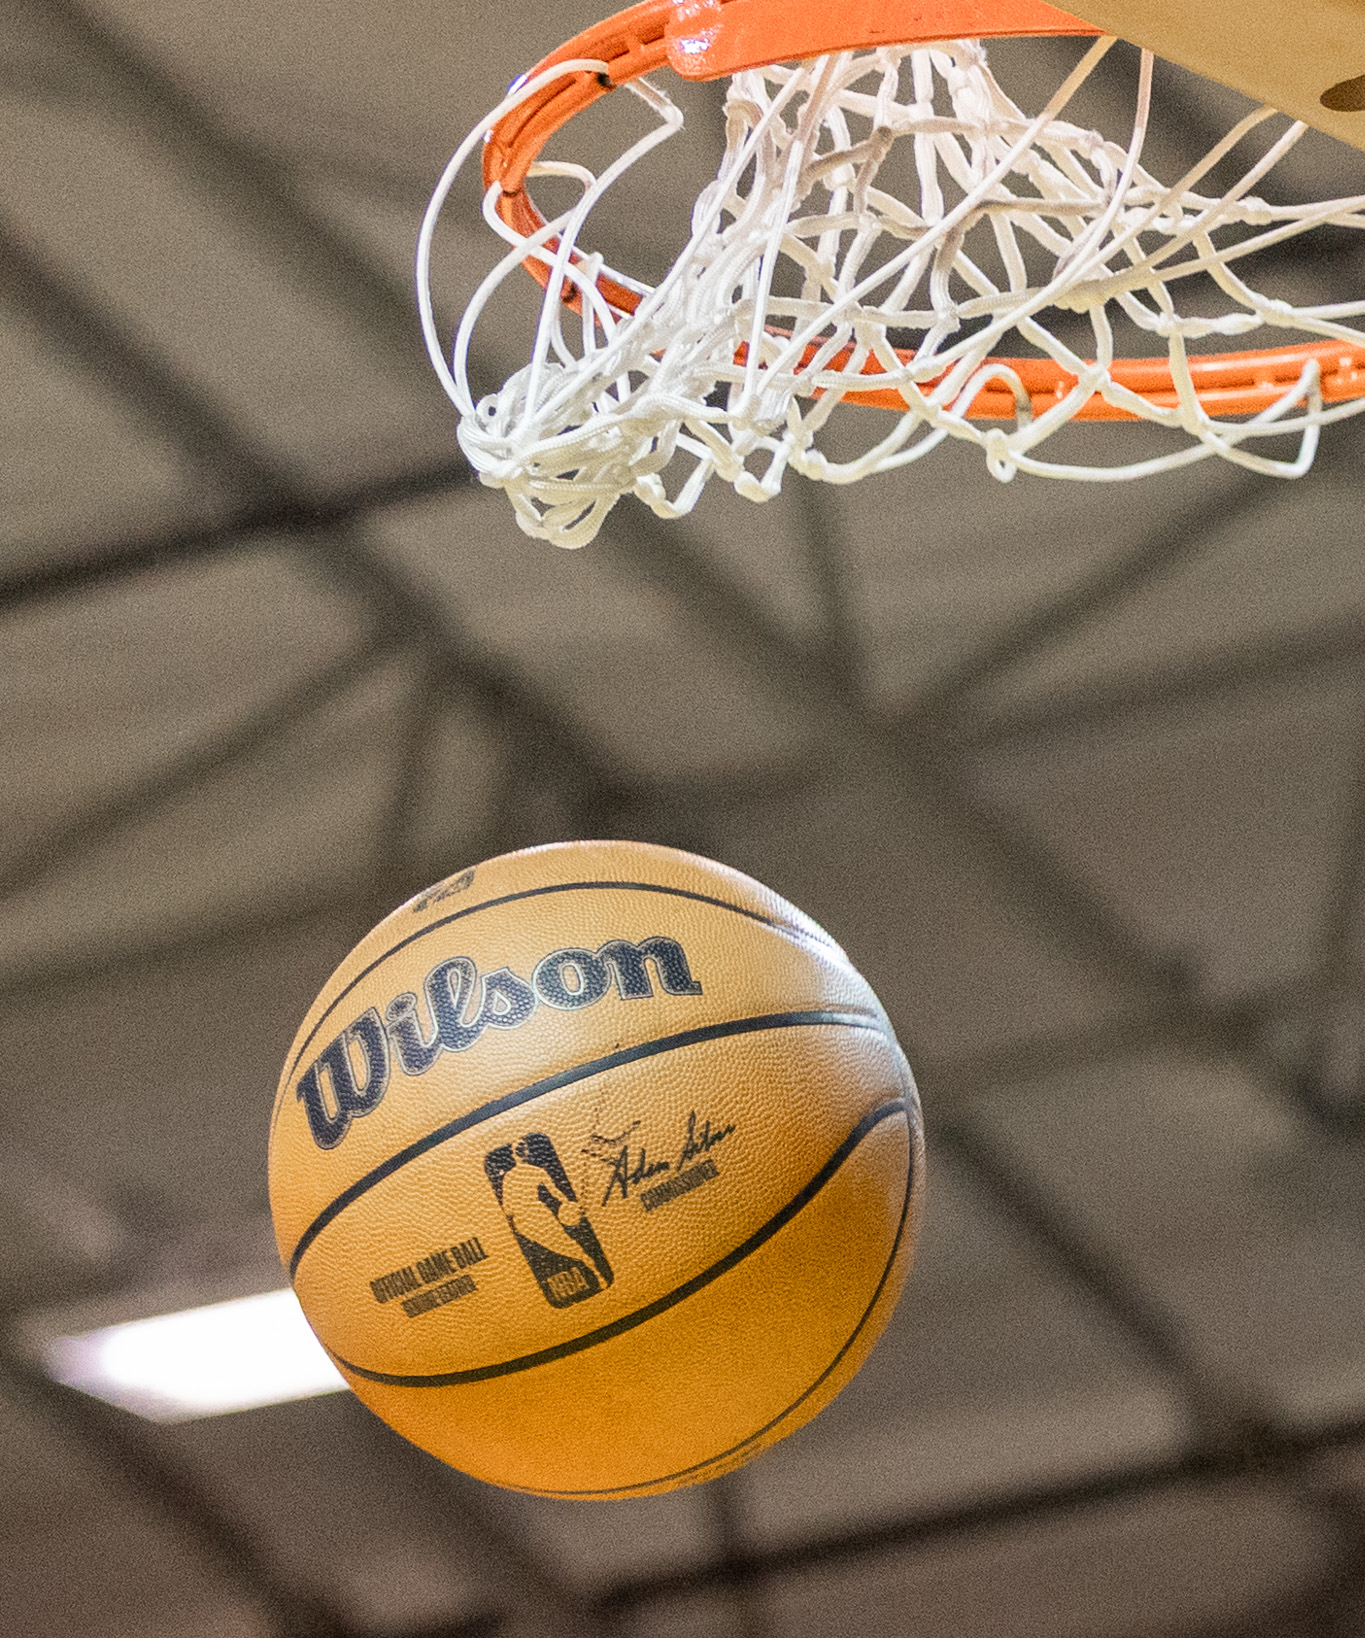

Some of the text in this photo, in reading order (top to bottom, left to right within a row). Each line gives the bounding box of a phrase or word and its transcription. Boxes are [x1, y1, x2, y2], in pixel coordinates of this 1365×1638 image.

[296, 935, 704, 1151] Wilson
[369, 1236, 489, 1304] OFFICIAL GAME BALL
[546, 1266, 590, 1301] NBA
